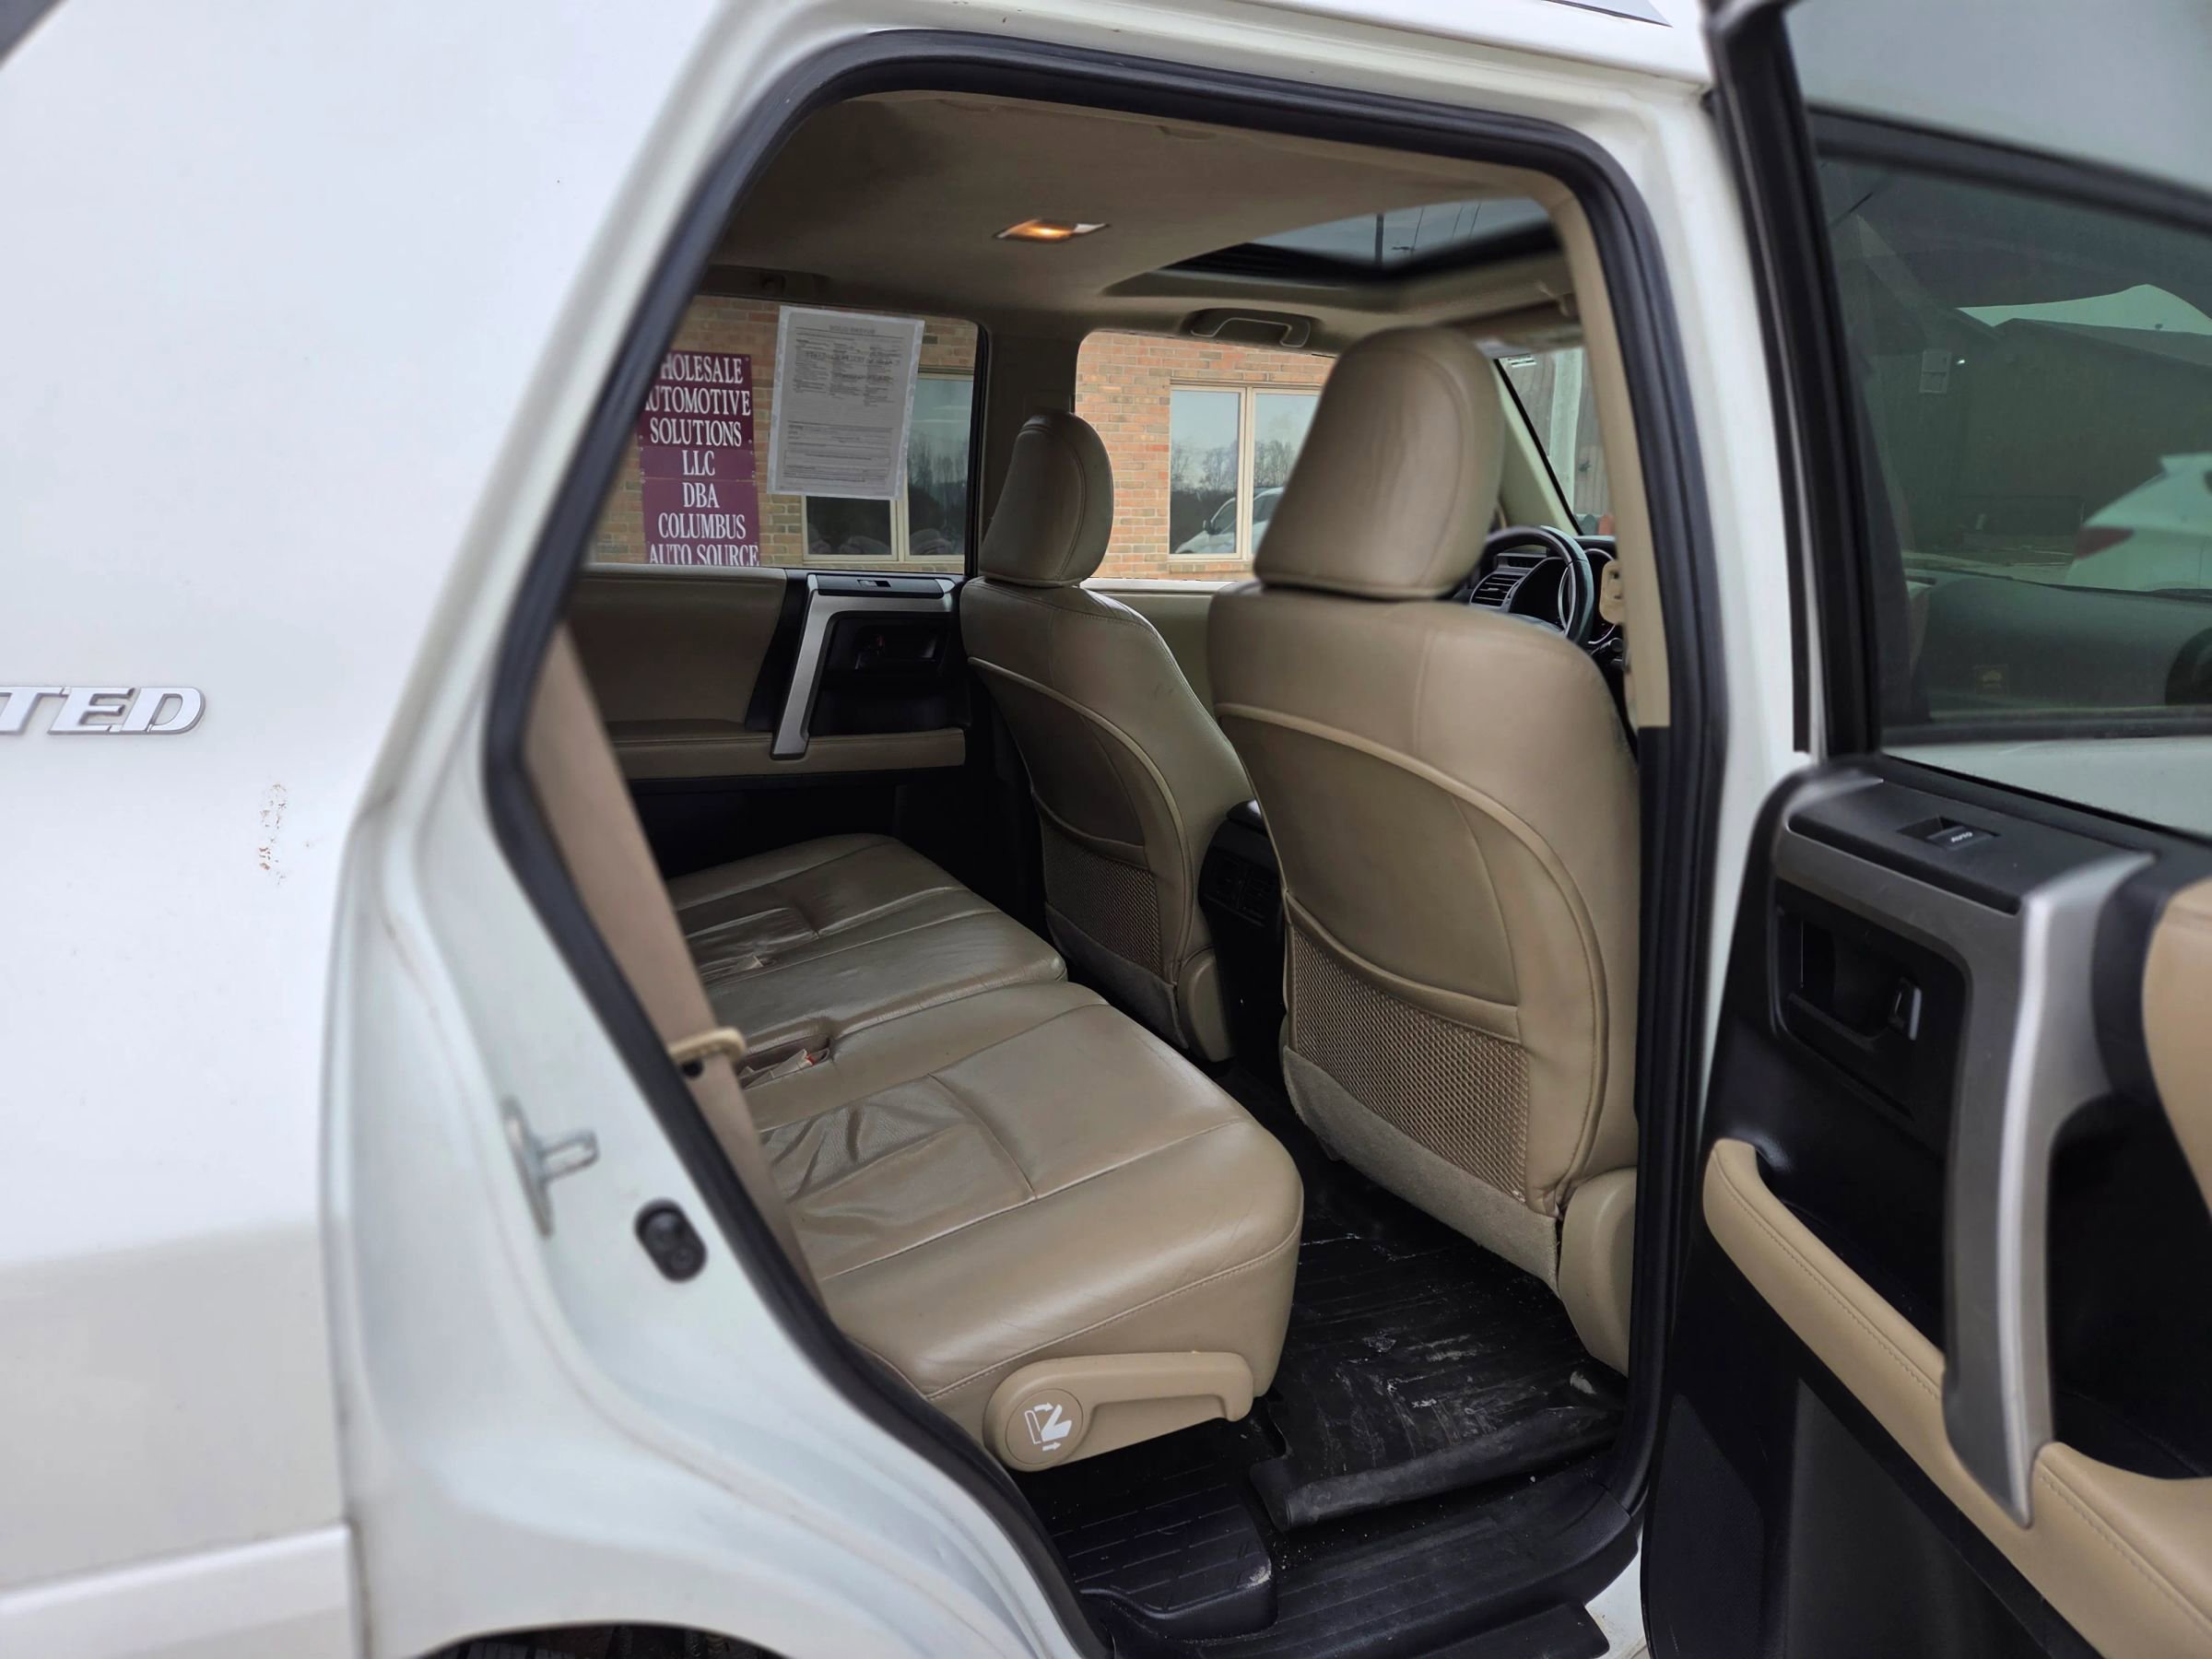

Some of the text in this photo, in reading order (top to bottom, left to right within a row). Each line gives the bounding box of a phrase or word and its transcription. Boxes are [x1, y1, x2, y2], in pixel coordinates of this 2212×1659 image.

[660, 353, 744, 384] HOLESALE
[645, 384, 752, 416] UTOMOTIVE
[650, 417, 743, 447] SOLUTIONS
[682, 450, 715, 477] LLC
[683, 482, 720, 508] DBA
[658, 512, 747, 539] COLUMBUS
[649, 543, 760, 567] AUTO SOURCE
